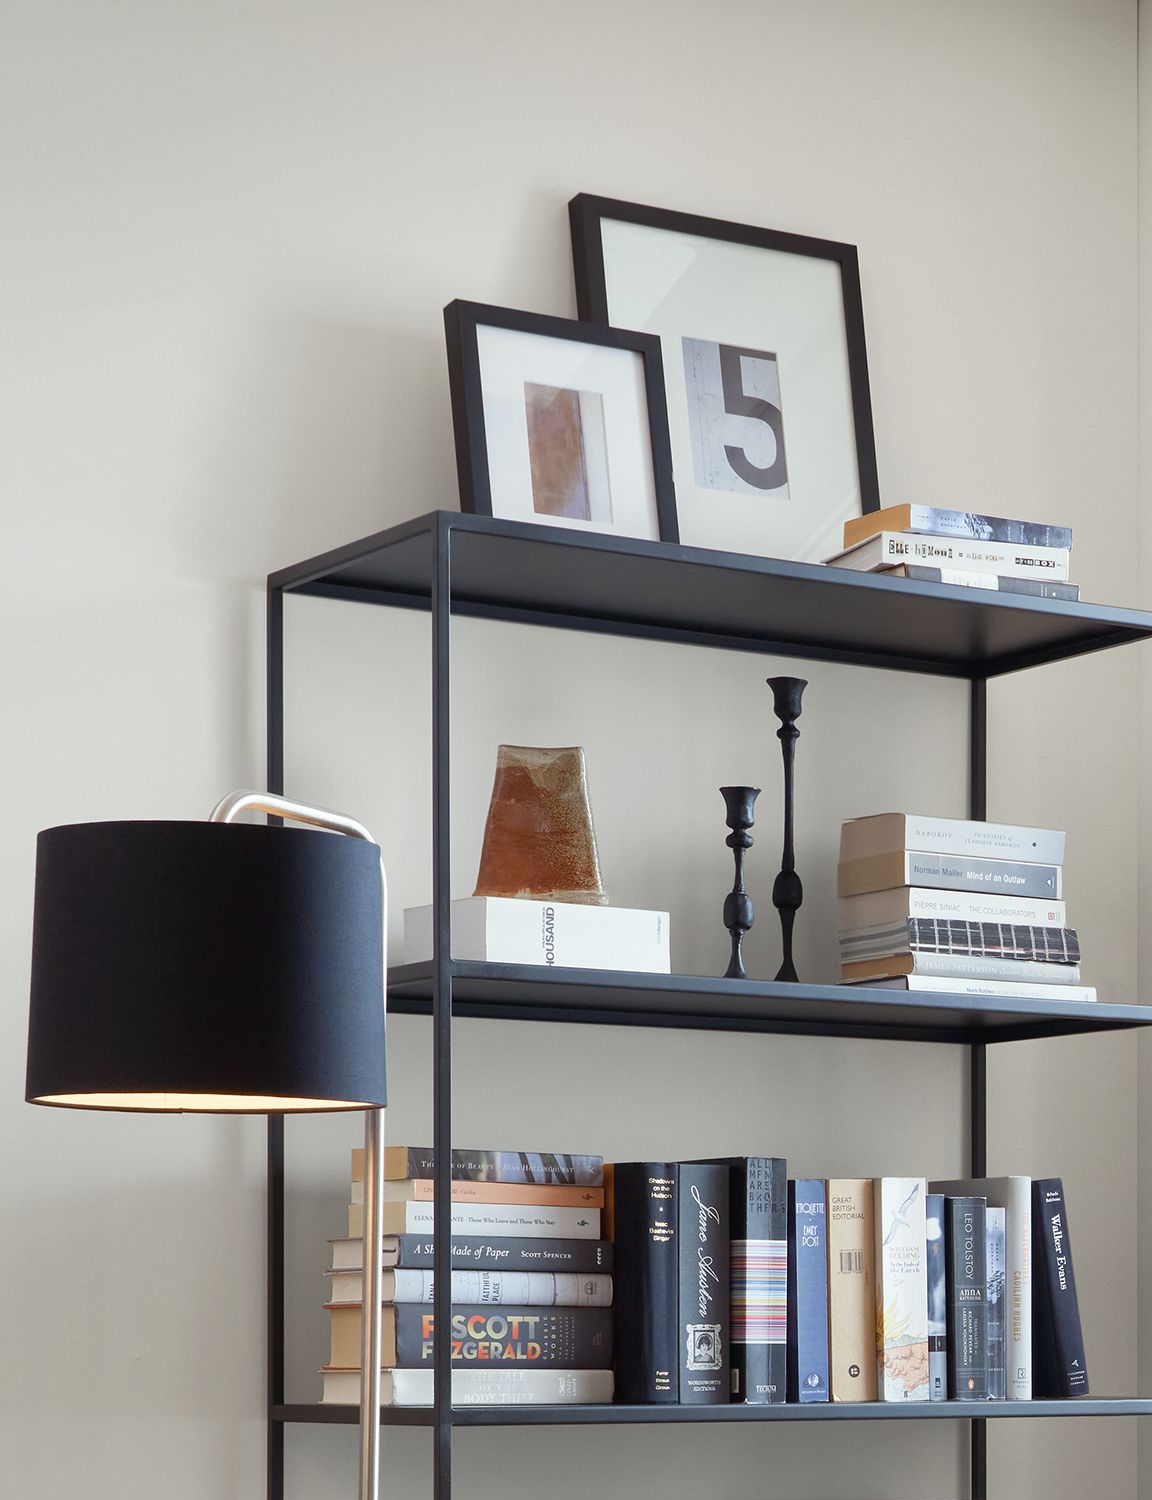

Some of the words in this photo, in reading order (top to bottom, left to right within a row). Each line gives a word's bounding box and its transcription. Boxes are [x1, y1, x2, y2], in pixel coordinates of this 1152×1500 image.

[718, 344, 789, 491] 5
[914, 864, 941, 876] Norman
[942, 868, 963, 878] Mailer
[966, 871, 984, 881] Mind
[984, 871, 993, 882] of
[993, 875, 1002, 883] an
[1003, 873, 1026, 885] Outlaw
[914, 901, 938, 910] PIERRE
[939, 903, 961, 912] SINIAC
[983, 906, 1037, 918] COLLABORATORS
[750, 1159, 770, 1168] ALL
[648, 1177, 675, 1185] Shadows
[750, 1181, 770, 1190] ARE
[690, 1184, 721, 1243] Jane
[796, 1202, 825, 1216] ETIQUETTE
[832, 1213, 865, 1221] EDITORIAL
[803, 1225, 818, 1236] EMILY
[964, 1213, 973, 1233] LEO
[1050, 1212, 1063, 1254] Walker
[802, 1236, 819, 1247] POST
[413, 1244, 421, 1254] A
[474, 1245, 485, 1260] of
[485, 1246, 510, 1260] Paper
[520, 1250, 542, 1258] SCOTT
[965, 1236, 975, 1280] TOLSTOY
[697, 1246, 720, 1318] Austen
[1056, 1256, 1067, 1291] Evans
[482, 1271, 490, 1302] FAITHFUL
[492, 1282, 500, 1302] PLACE
[451, 1314, 541, 1340] SCOTT
[1013, 1311, 1021, 1343] HUGHES
[422, 1341, 541, 1360] FZGERALD
